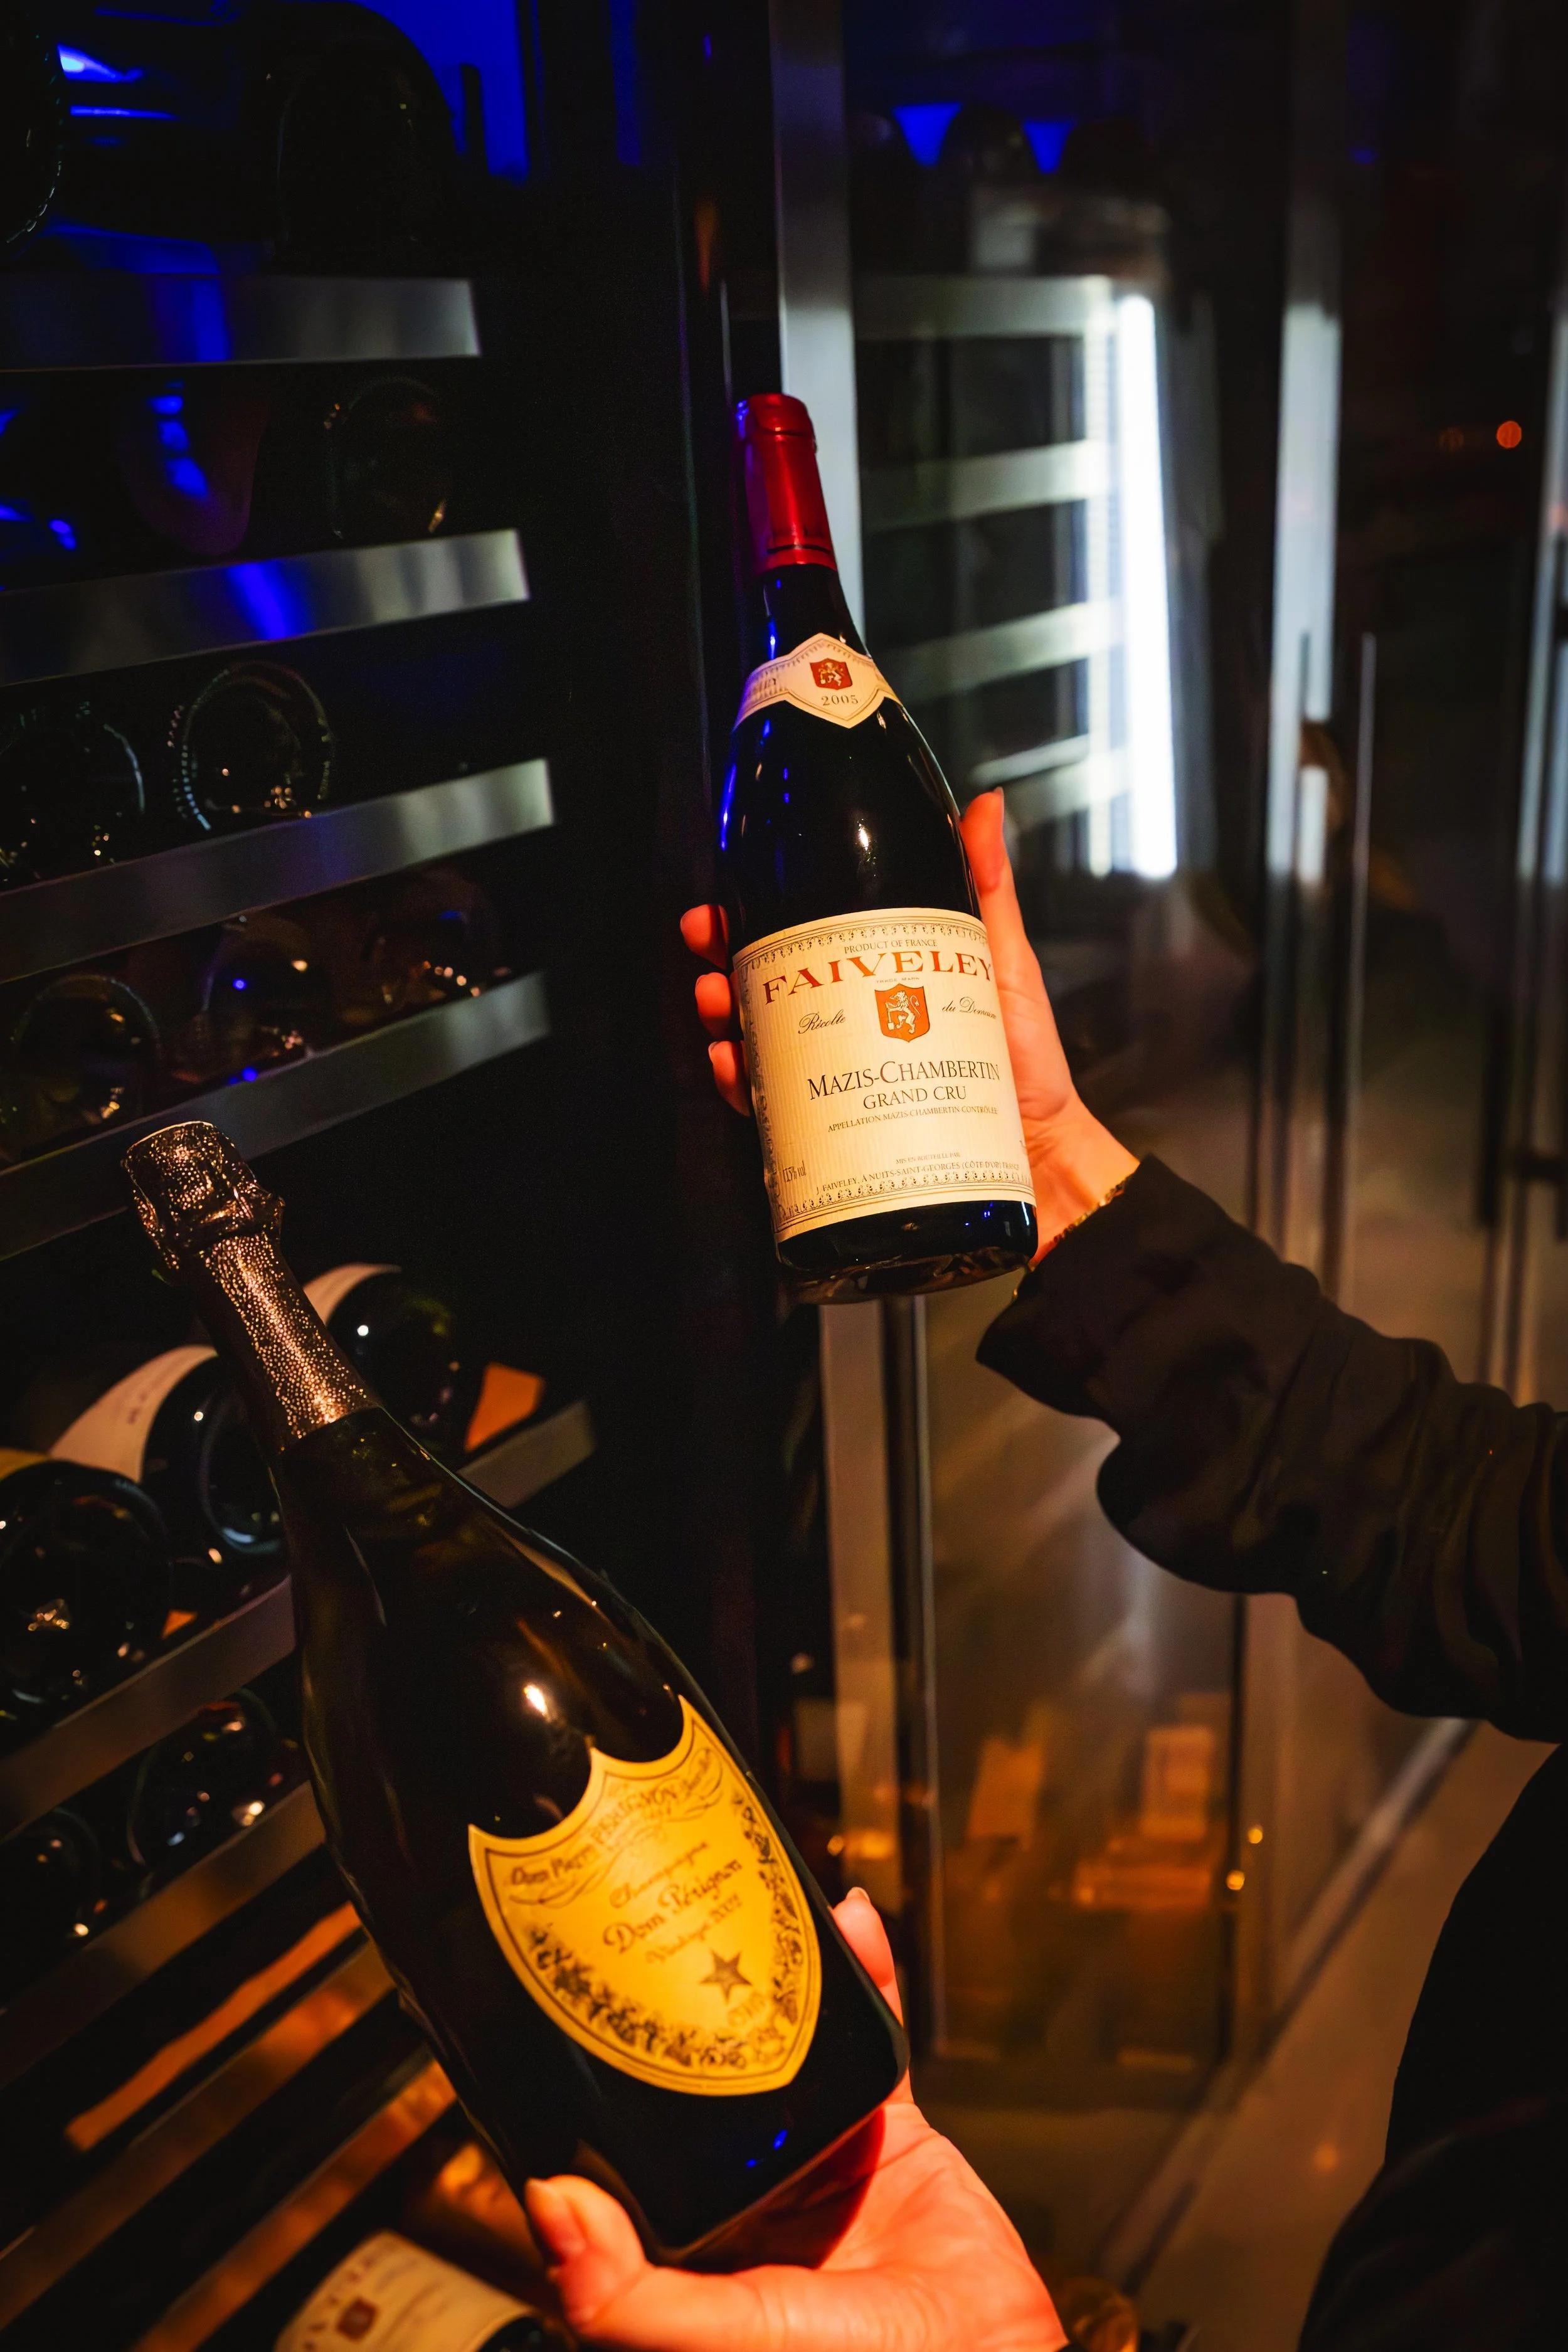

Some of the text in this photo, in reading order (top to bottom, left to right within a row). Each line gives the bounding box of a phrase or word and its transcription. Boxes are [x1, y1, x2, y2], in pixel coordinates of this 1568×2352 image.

[821, 694, 859, 706] 2005
[844, 941, 889, 954] PRODUCT
[905, 938, 938, 947] FRANCE
[762, 950, 992, 1005] FAIVELEY
[941, 1000, 956, 1012] du
[807, 1060, 1000, 1100] MAZIS-CHAMBERTIN
[862, 1086, 967, 1110] GRAND CRU
[828, 1114, 881, 1133] APPELLATION
[869, 1162, 961, 1182] NUITS-SAINT-GEORGES
[602, 1858, 743, 1956] Dom Pérignon
